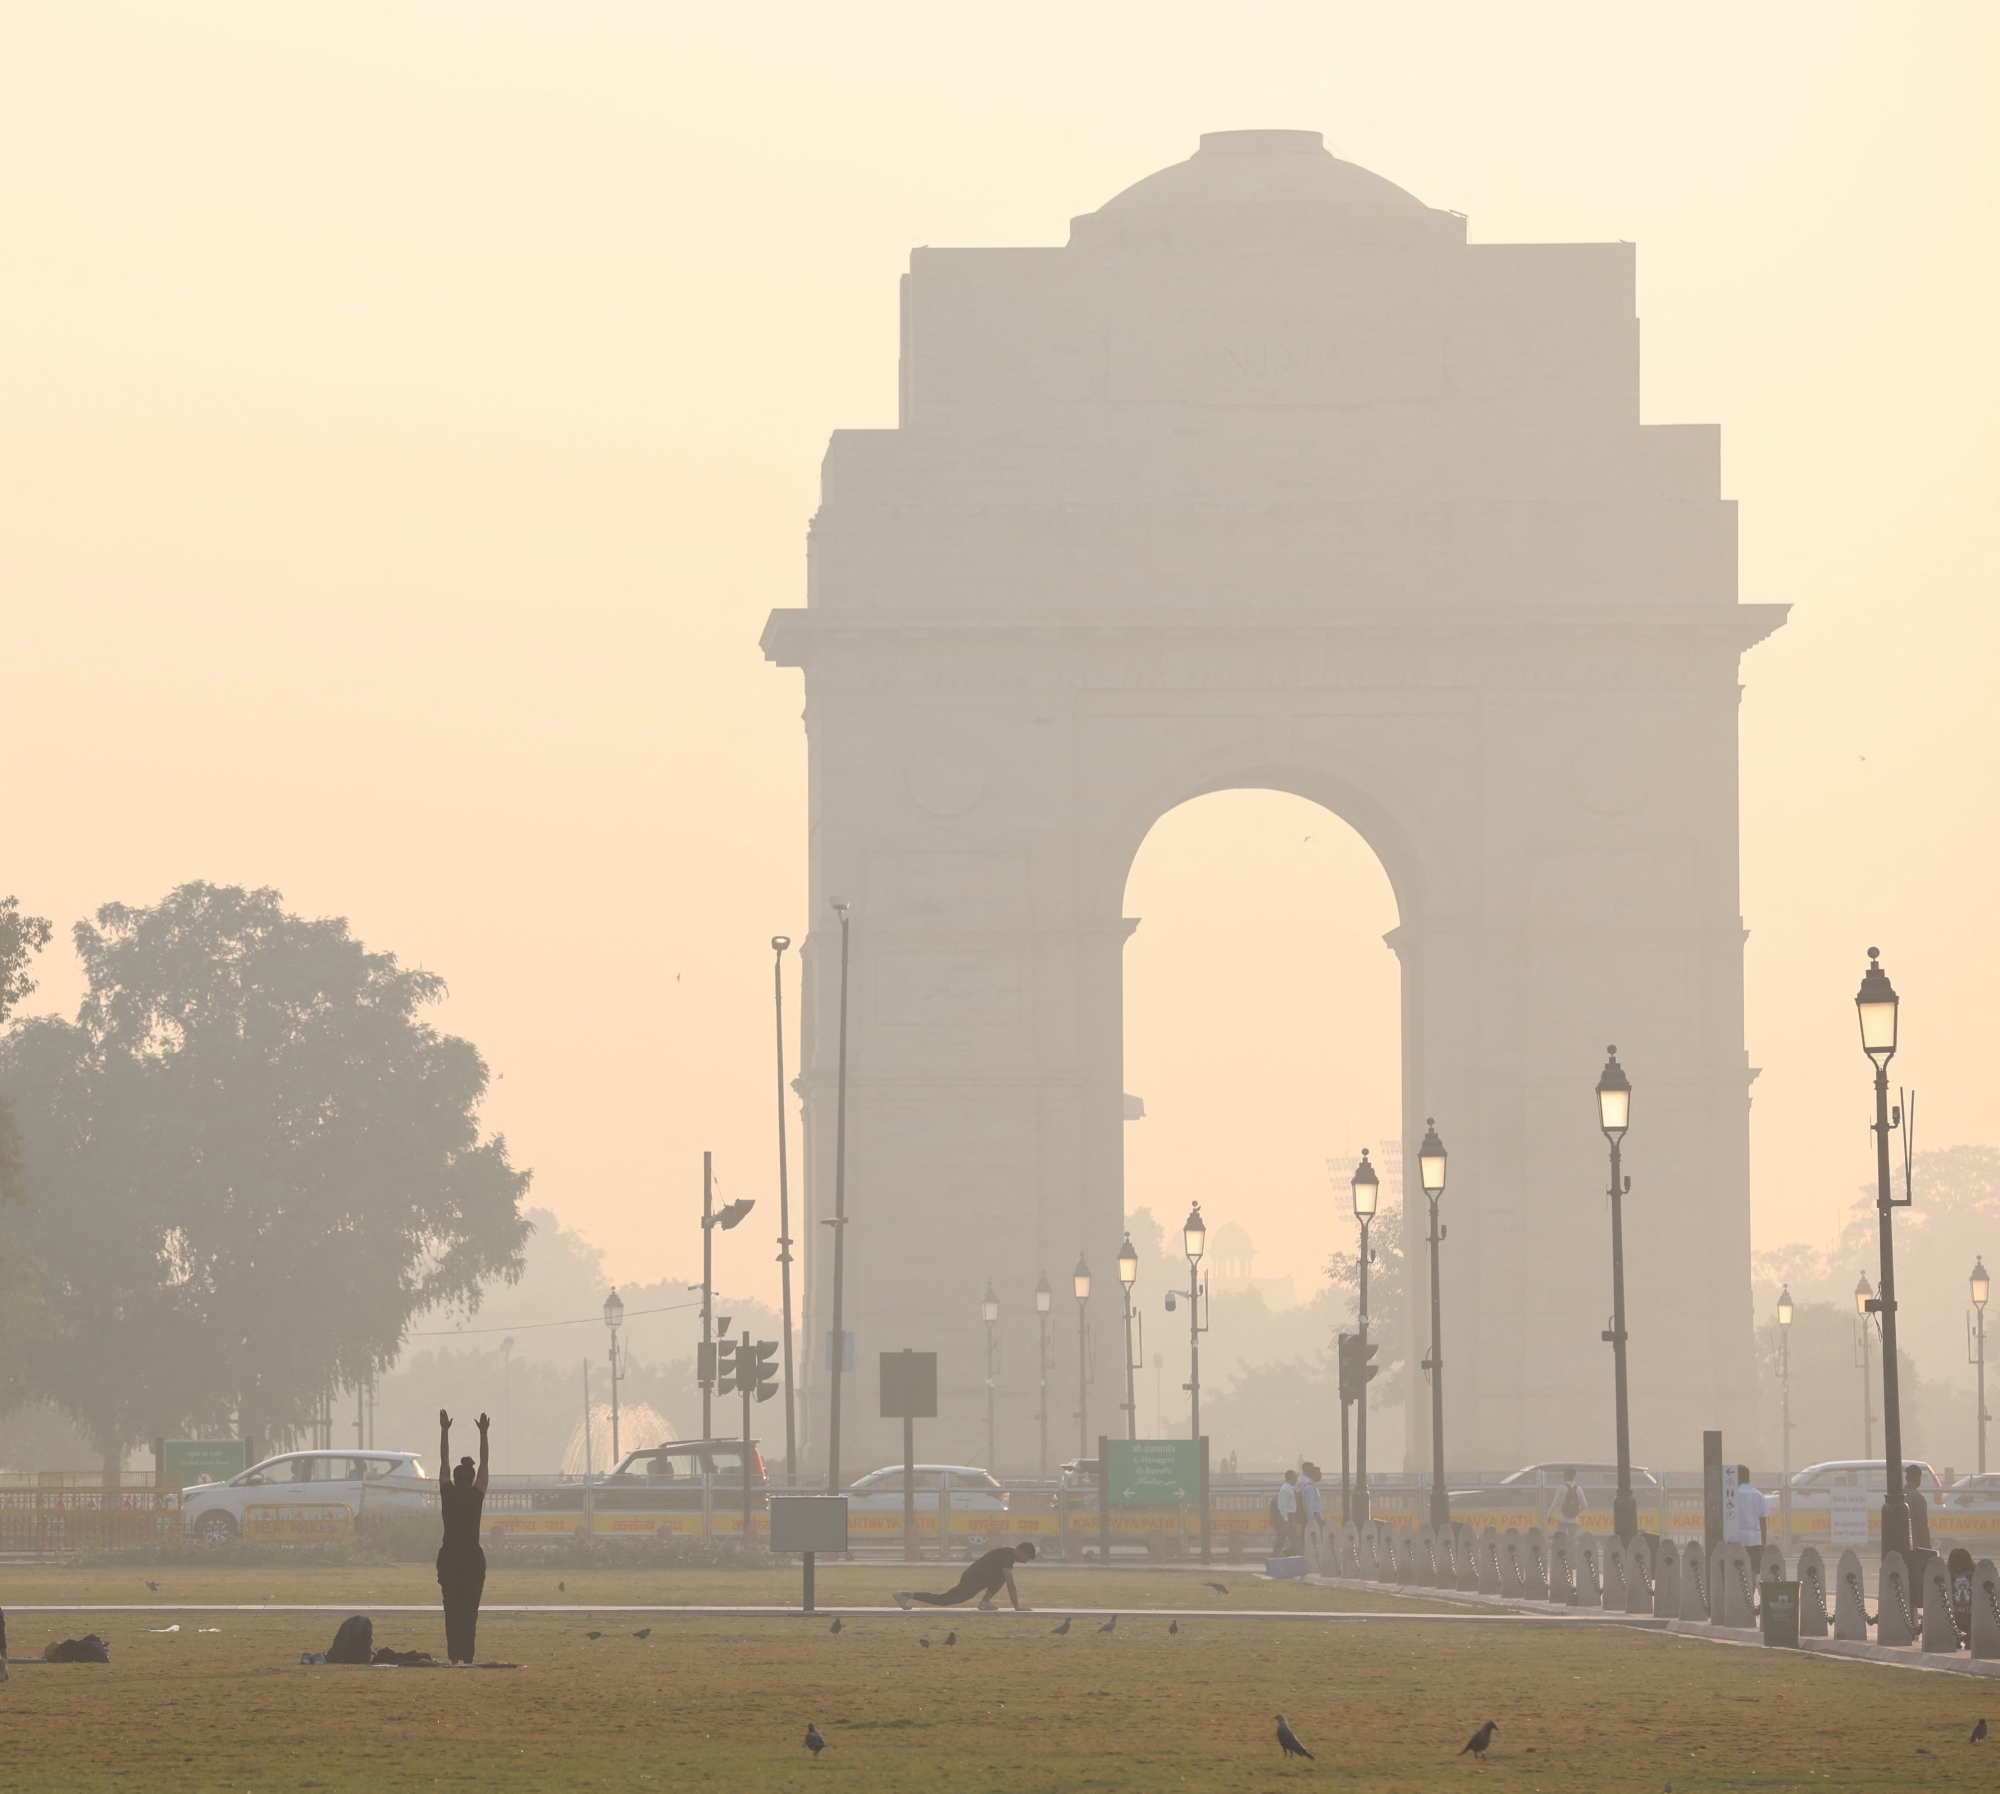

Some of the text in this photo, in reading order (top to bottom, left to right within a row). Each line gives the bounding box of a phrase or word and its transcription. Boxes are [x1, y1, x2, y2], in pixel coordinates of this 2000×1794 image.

[1133, 1456, 1175, 1466] C-Hexagon
[544, 1520, 564, 1531] पथ
[847, 1517, 900, 1528] ARTAVYA
[1018, 1520, 1039, 1531] पथ
[1073, 1517, 1174, 1529] KARAVYA PATH
[1502, 1515, 1533, 1526] PATH
[1930, 1518, 1987, 1529] ARTAVYA
[254, 1521, 326, 1534] DELHI POLICE
